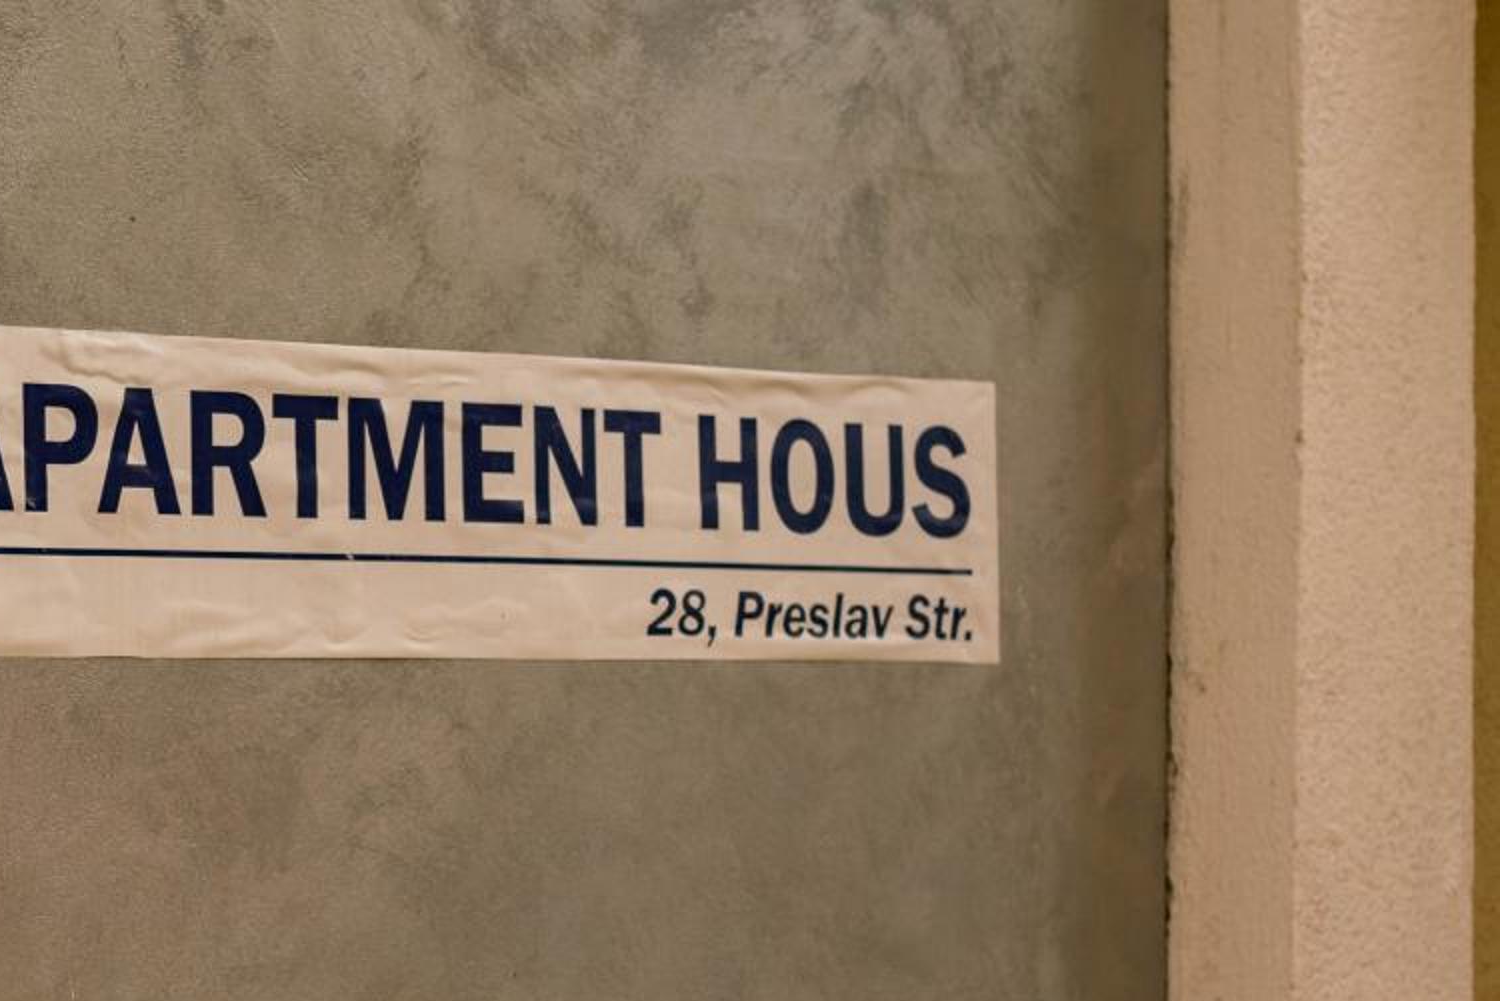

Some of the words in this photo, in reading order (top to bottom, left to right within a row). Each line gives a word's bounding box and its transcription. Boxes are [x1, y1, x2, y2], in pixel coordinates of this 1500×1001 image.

[697, 413, 972, 538] HOUS
[646, 588, 717, 647] 28,
[734, 591, 894, 639] Preslav
[904, 594, 973, 642] Str.
